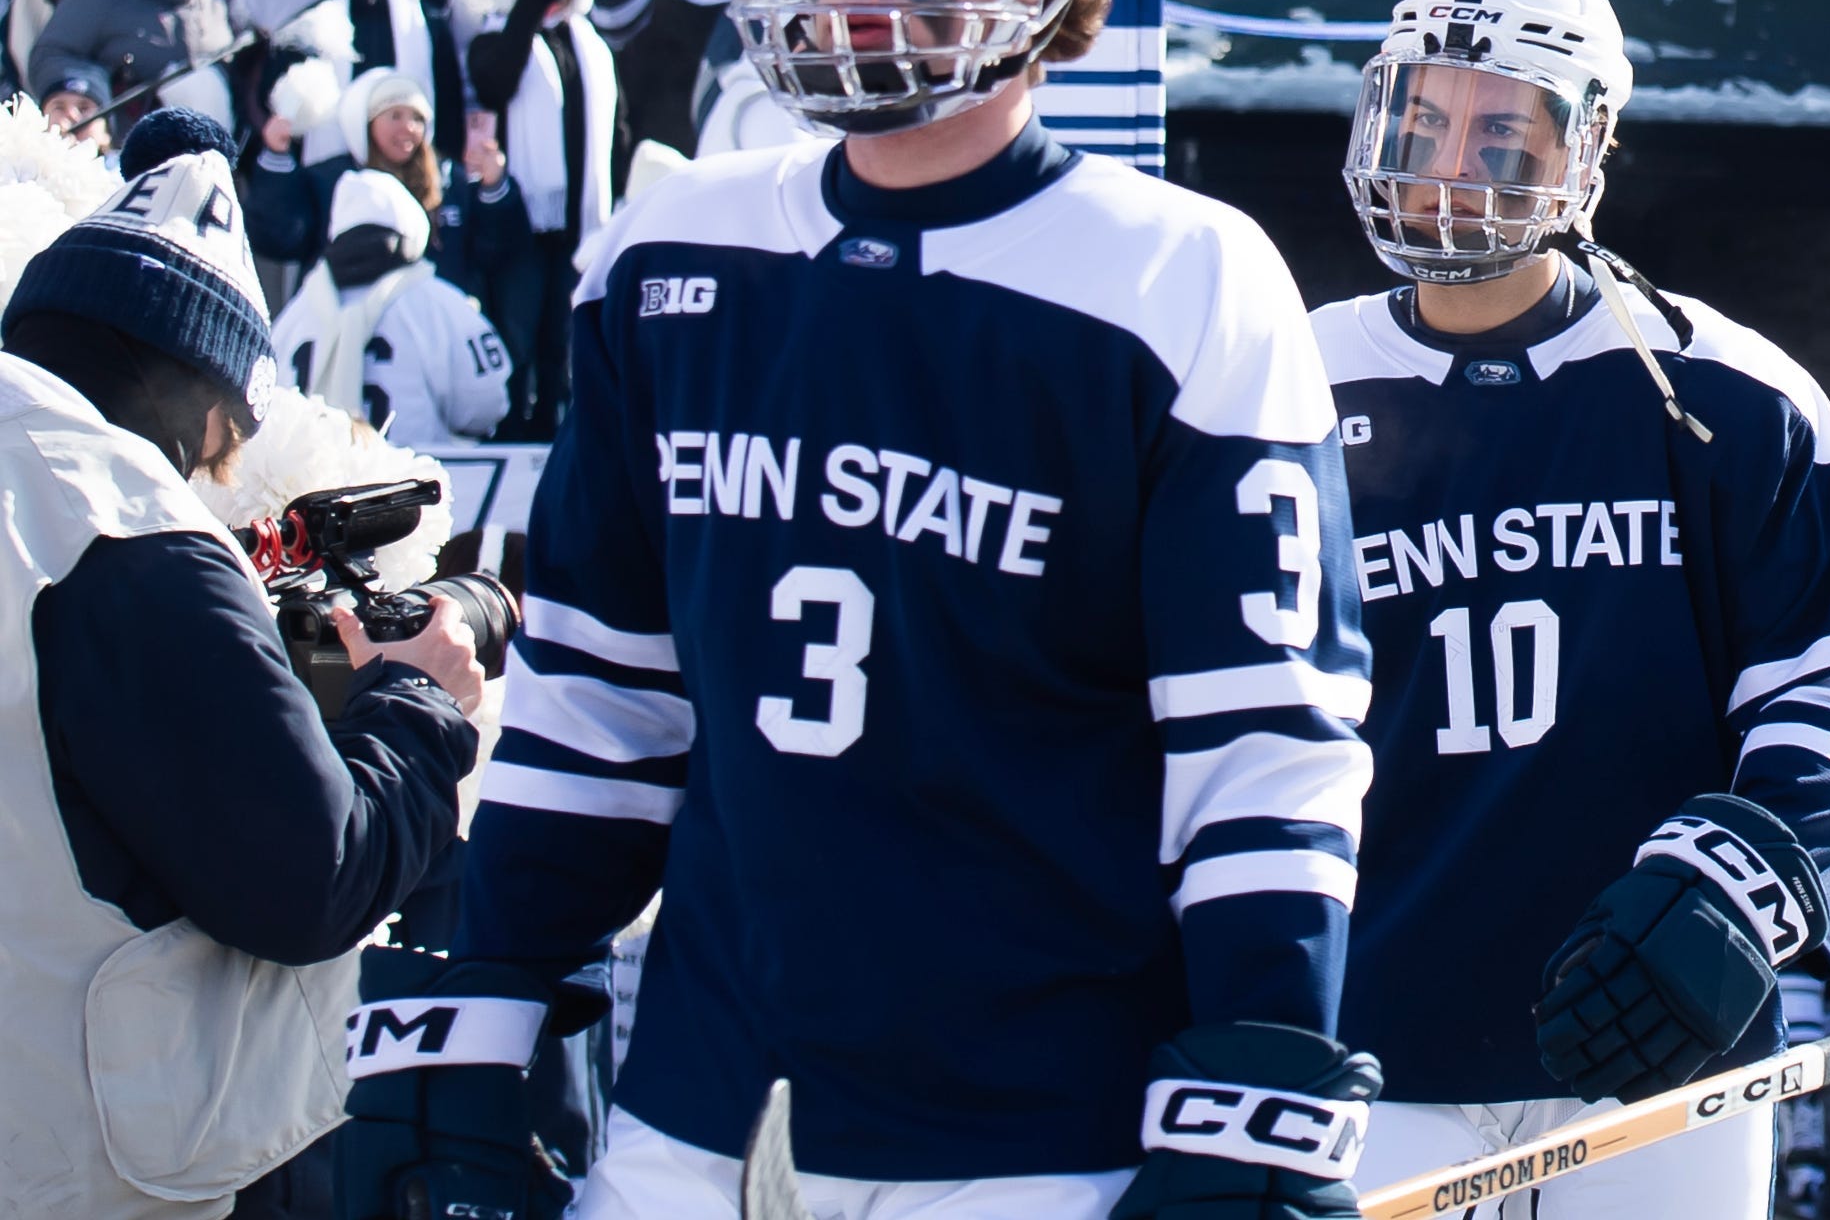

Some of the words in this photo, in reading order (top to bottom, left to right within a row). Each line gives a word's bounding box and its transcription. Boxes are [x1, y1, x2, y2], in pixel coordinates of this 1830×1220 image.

[1429, 6, 1503, 24] CCM
[1413, 266, 1472, 280] CCM
[1577, 240, 1635, 277] CCM
[467, 331, 503, 377] 16
[821, 443, 1063, 577] STATE
[1236, 459, 1322, 649] 3
[1352, 514, 1477, 603] ENN
[1493, 500, 1684, 572] STATE
[756, 565, 875, 757] 3
[1430, 598, 1560, 755] 10
[1434, 1153, 1535, 1213] CUSTOM
[1541, 1138, 1588, 1177] PRO
